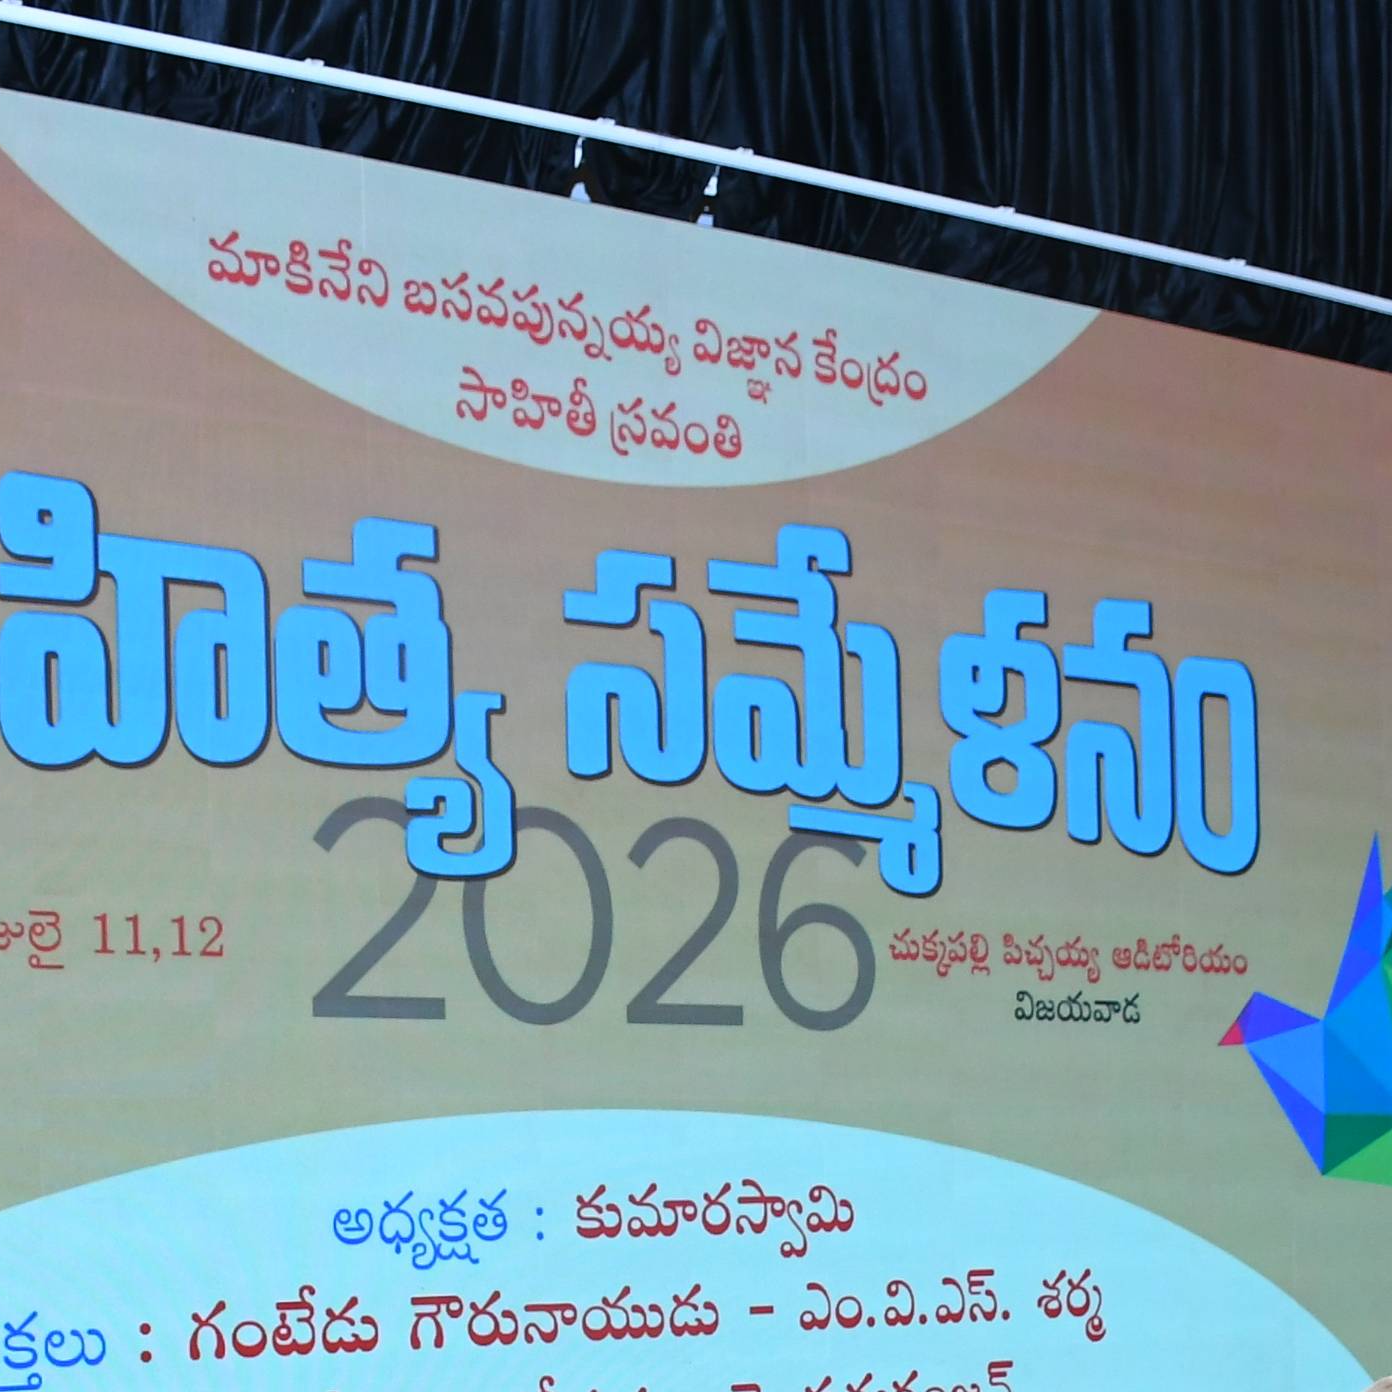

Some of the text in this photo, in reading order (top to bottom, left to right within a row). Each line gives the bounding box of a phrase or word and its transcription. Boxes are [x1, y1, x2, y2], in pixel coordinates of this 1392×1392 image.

[208, 231, 928, 405] మాకినేని బసవపున్నయ్య విజ్ఞాన కేంద్రం
[455, 366, 742, 459] సాహితీ స్రవంతి
[562, 524, 1260, 898] సమ్మేళనం
[97, 914, 224, 957] 11,12
[311, 796, 876, 1032] 2026
[1015, 991, 1140, 1023] విజయవాడ
[333, 1189, 507, 1270] అధ్యక్షత
[577, 1179, 854, 1258] కుమారస్వామి
[188, 1285, 379, 1360] గంటేడు
[410, 1284, 720, 1349] గౌరునాయుడు
[800, 1269, 1010, 1330] ఎం.వి.ఎస్.
[1038, 1270, 1104, 1342] శర్మ
